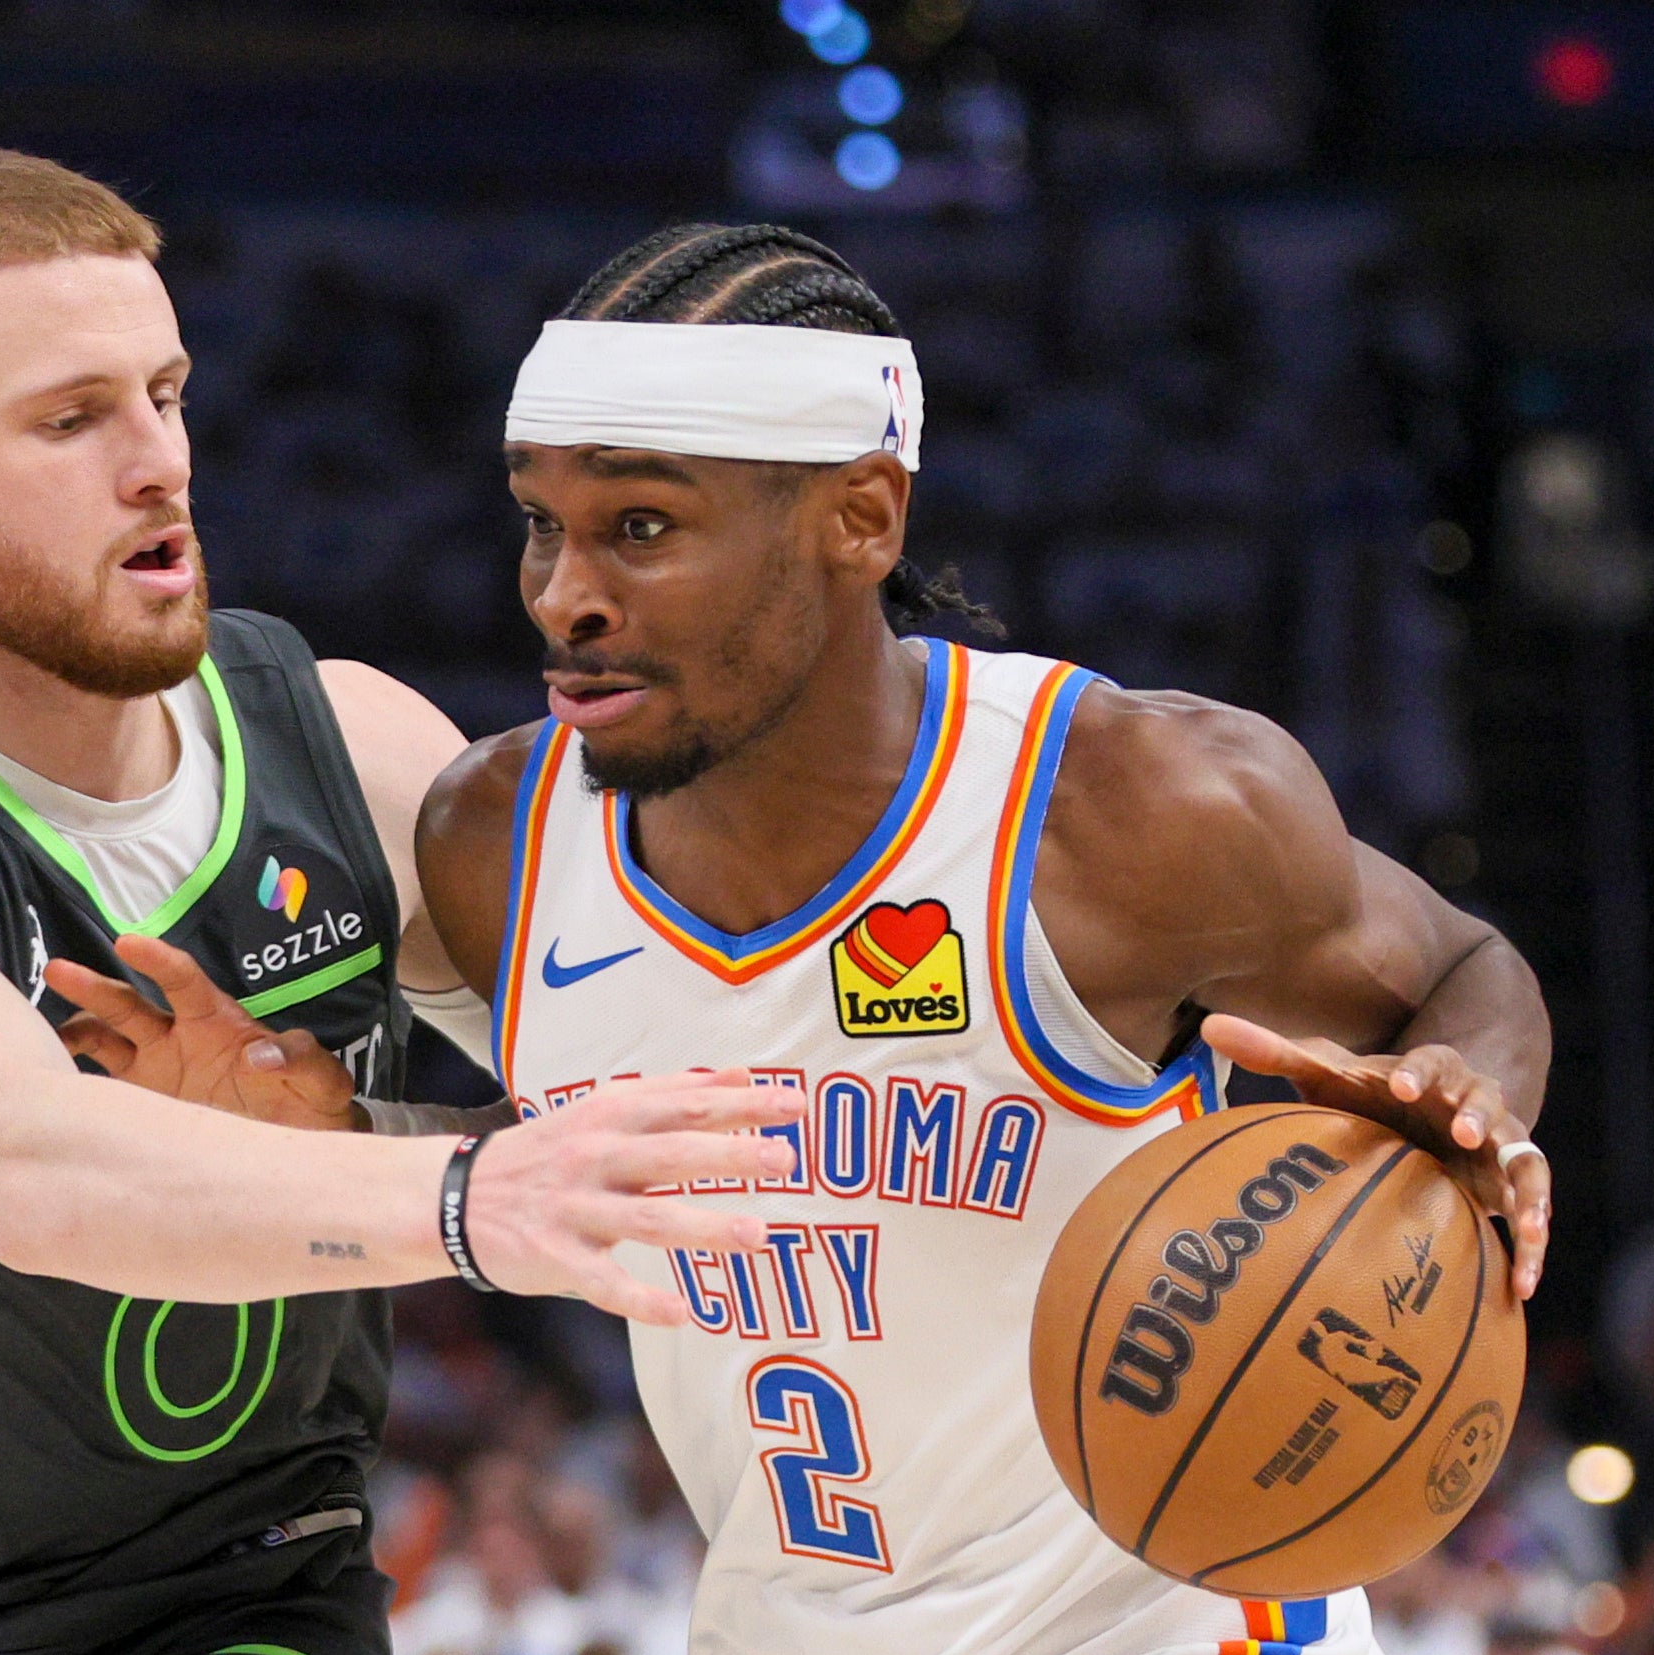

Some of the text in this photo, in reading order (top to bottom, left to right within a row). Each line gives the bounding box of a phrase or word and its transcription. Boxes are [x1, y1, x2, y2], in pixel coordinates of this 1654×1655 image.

[242, 908, 364, 981] sezzle
[666, 1223, 883, 1341] CITY
[1098, 1142, 1349, 1418] Wilson
[747, 1355, 894, 1574] 2
